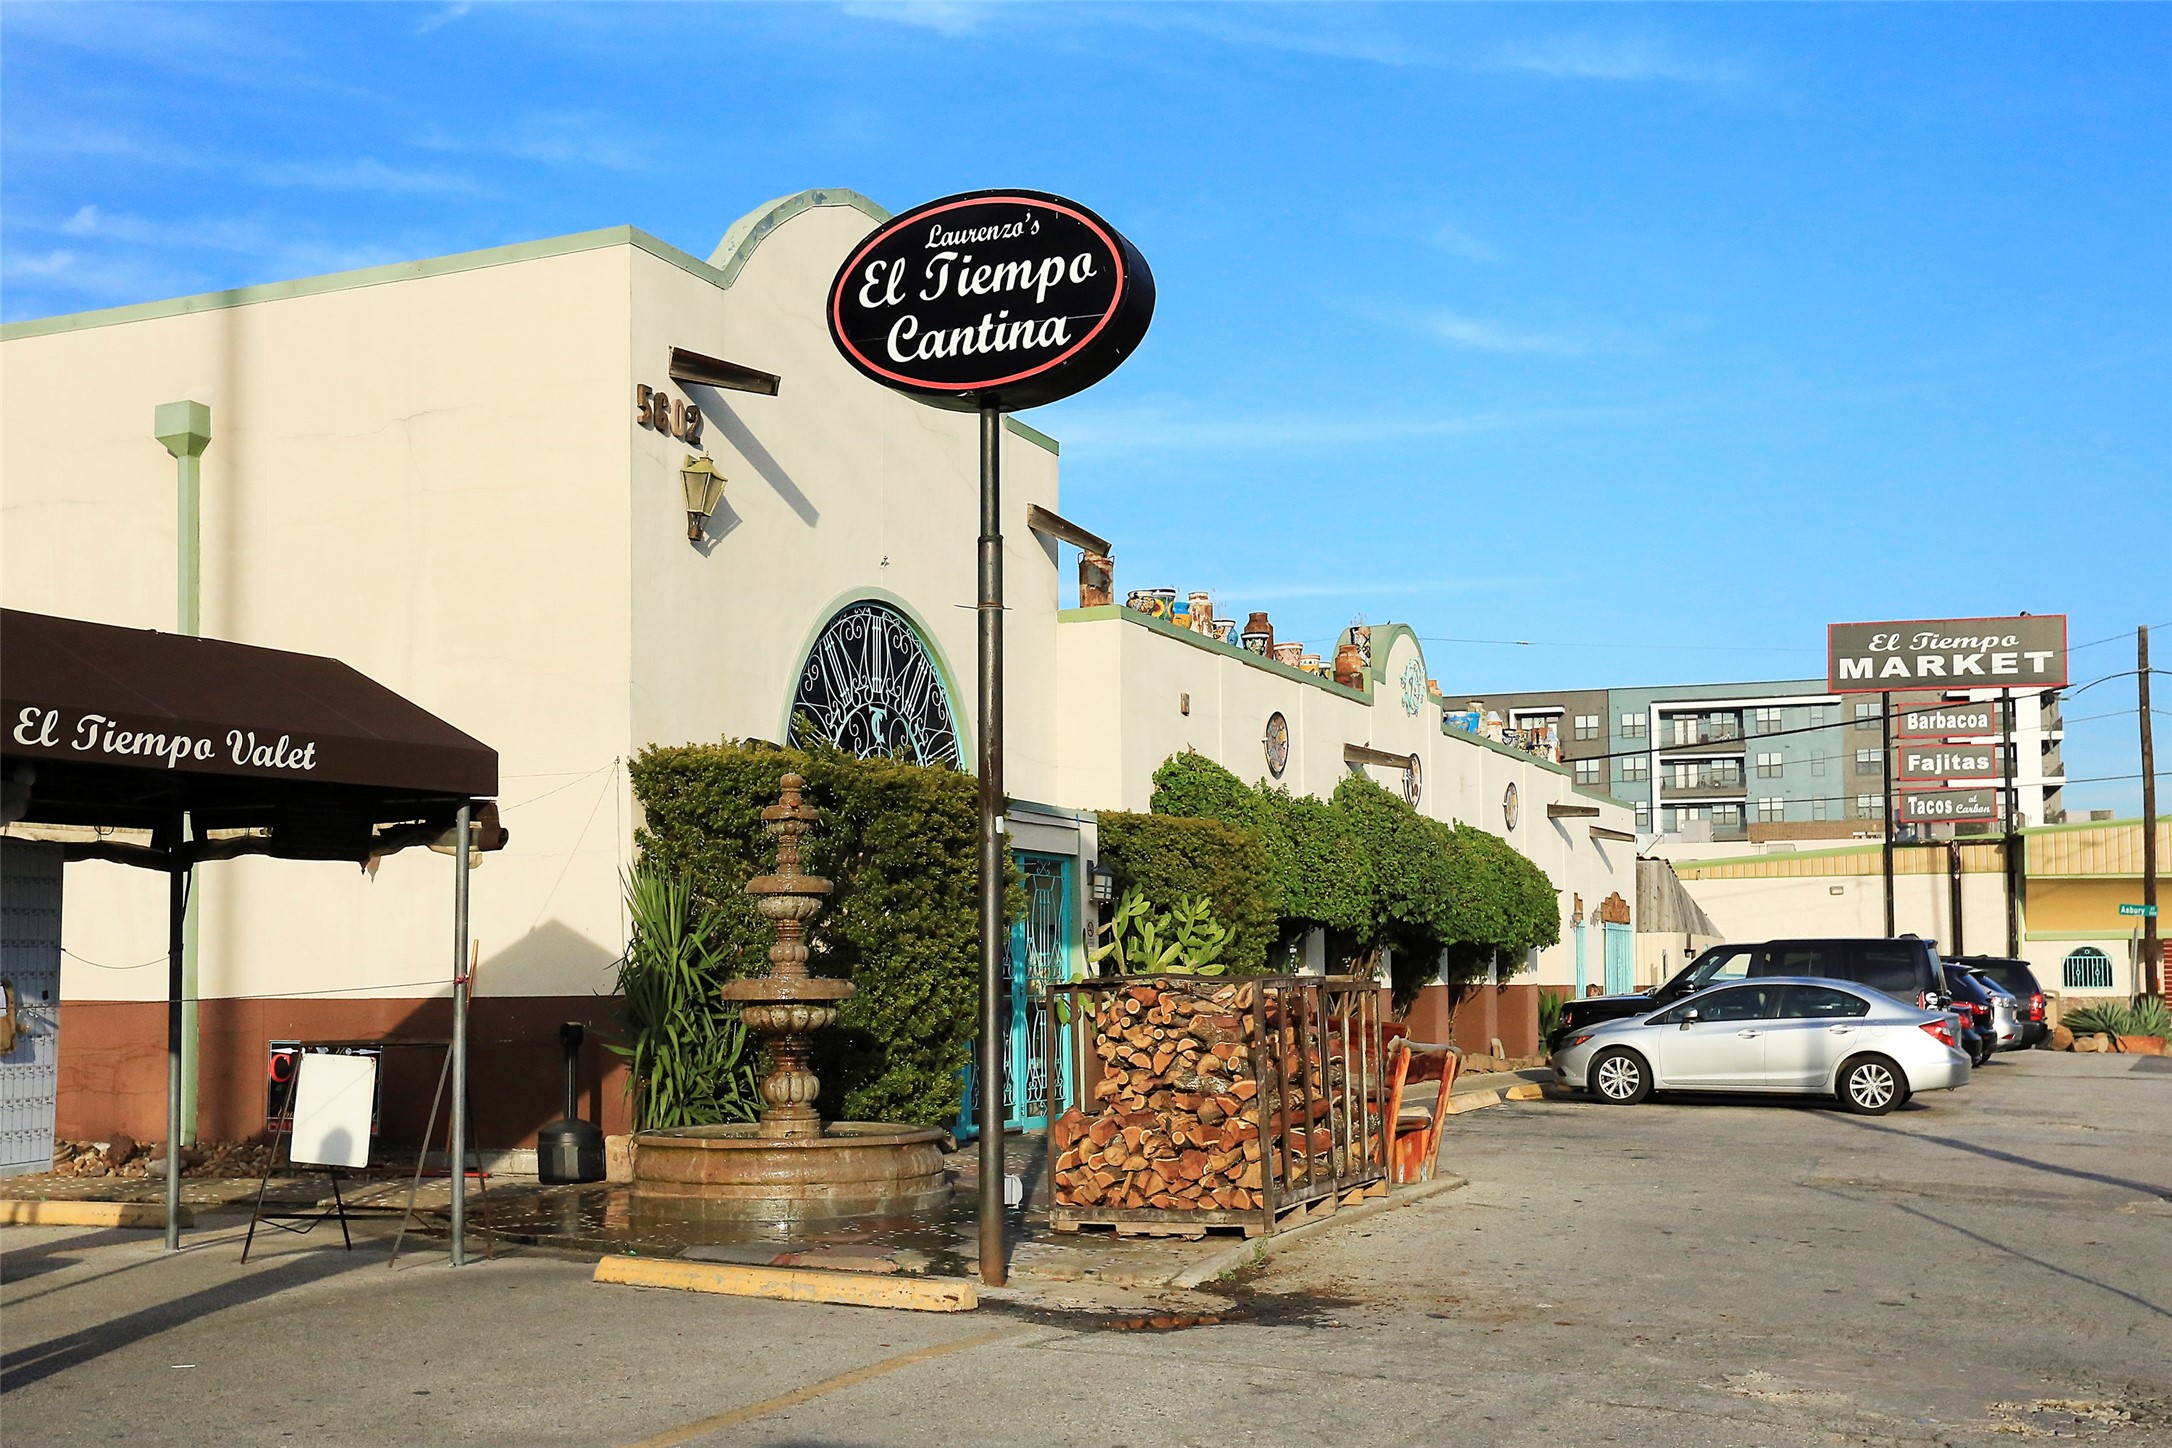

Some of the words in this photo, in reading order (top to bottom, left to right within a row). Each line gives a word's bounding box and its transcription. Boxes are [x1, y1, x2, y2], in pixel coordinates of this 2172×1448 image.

[925, 213, 1040, 249] Laurenzo's
[859, 258, 906, 308] El
[920, 252, 1097, 304] Tiempo
[887, 311, 1071, 363] Cantina
[637, 384, 702, 445] 5602
[1868, 633, 1901, 652] El
[1909, 632, 2019, 653] Tiempo
[1839, 651, 2054, 680] MARKET
[1907, 711, 1988, 730] Barbacoa
[13, 707, 59, 747] El
[71, 714, 215, 769] Tiempo
[226, 729, 317, 770] Valet
[1908, 753, 1990, 775] Fajitas
[1907, 796, 1953, 815] Tacos
[1956, 804, 1990, 814] Carbon
[1968, 795, 1978, 803] al
[2120, 905, 2146, 916] Asbury
